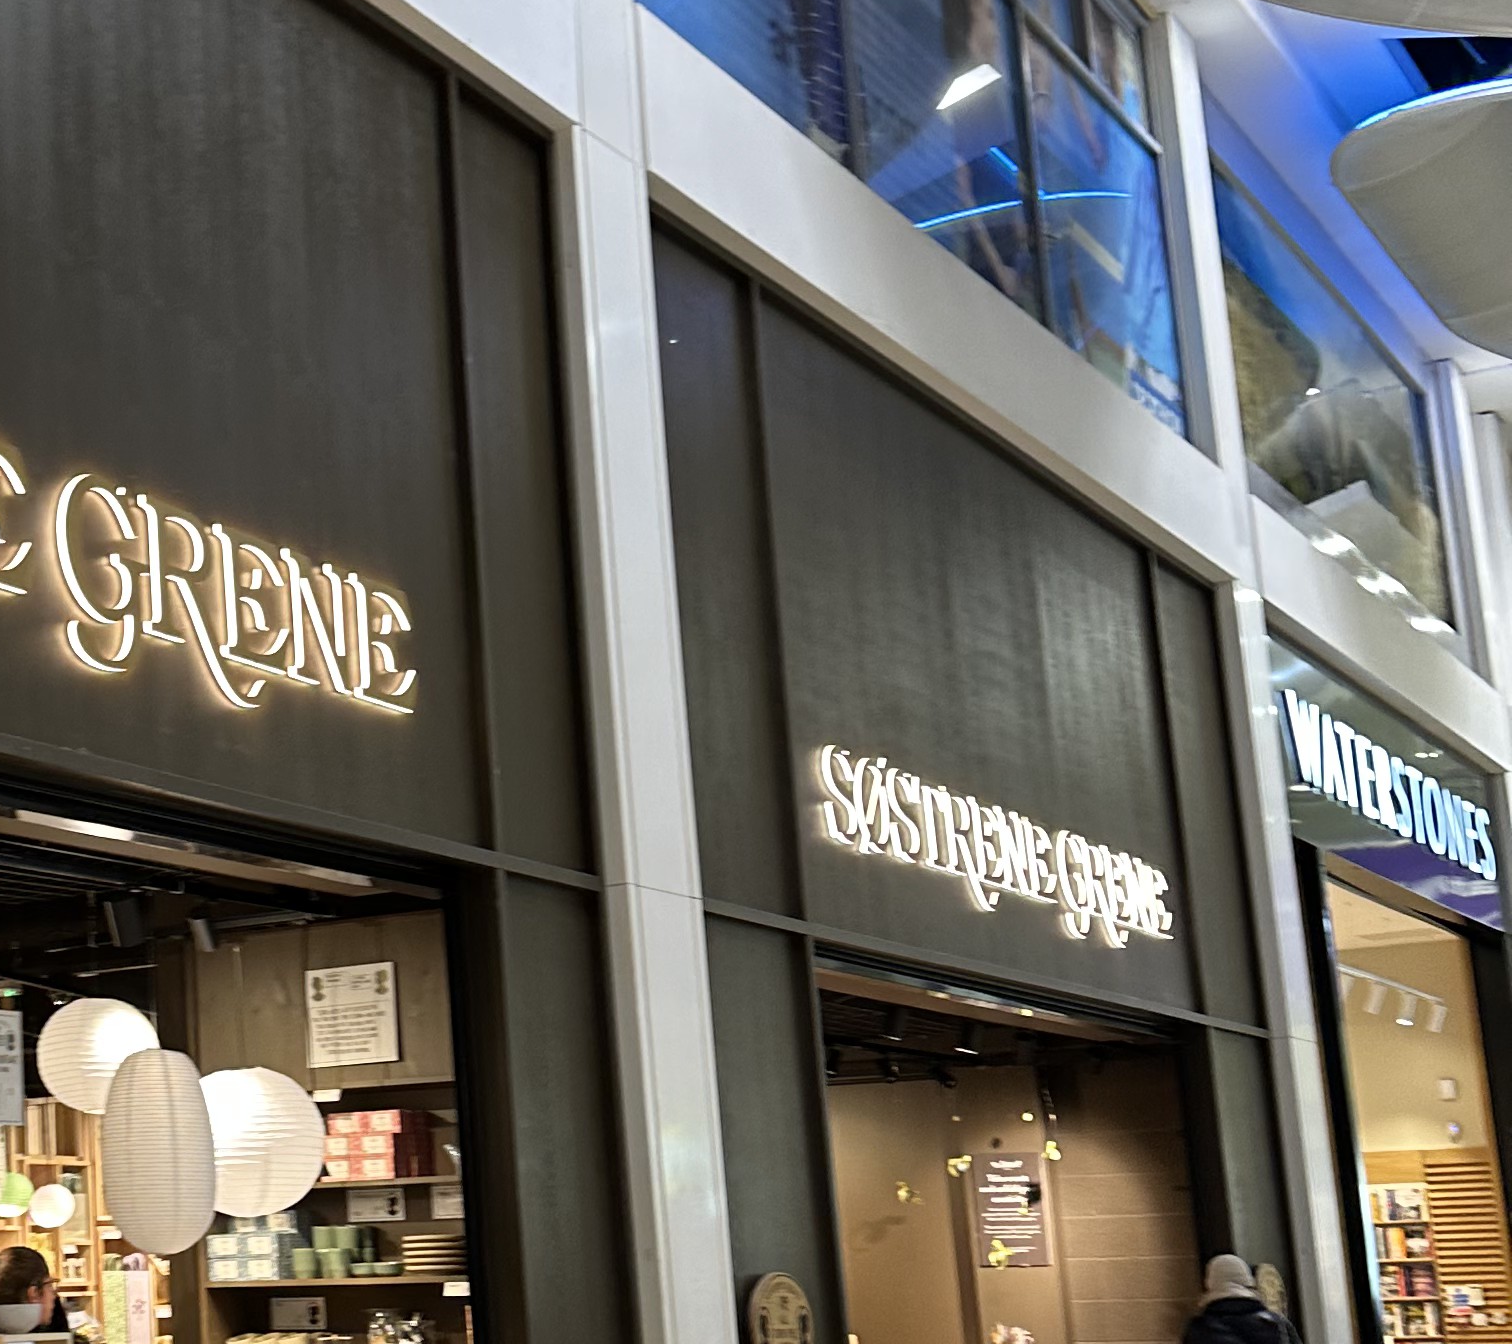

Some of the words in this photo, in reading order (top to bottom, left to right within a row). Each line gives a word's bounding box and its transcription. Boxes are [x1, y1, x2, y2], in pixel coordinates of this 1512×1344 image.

[54, 471, 422, 714] GRENE
[1283, 688, 1497, 881] WATERSTONES
[1054, 829, 1175, 949] GRENE
